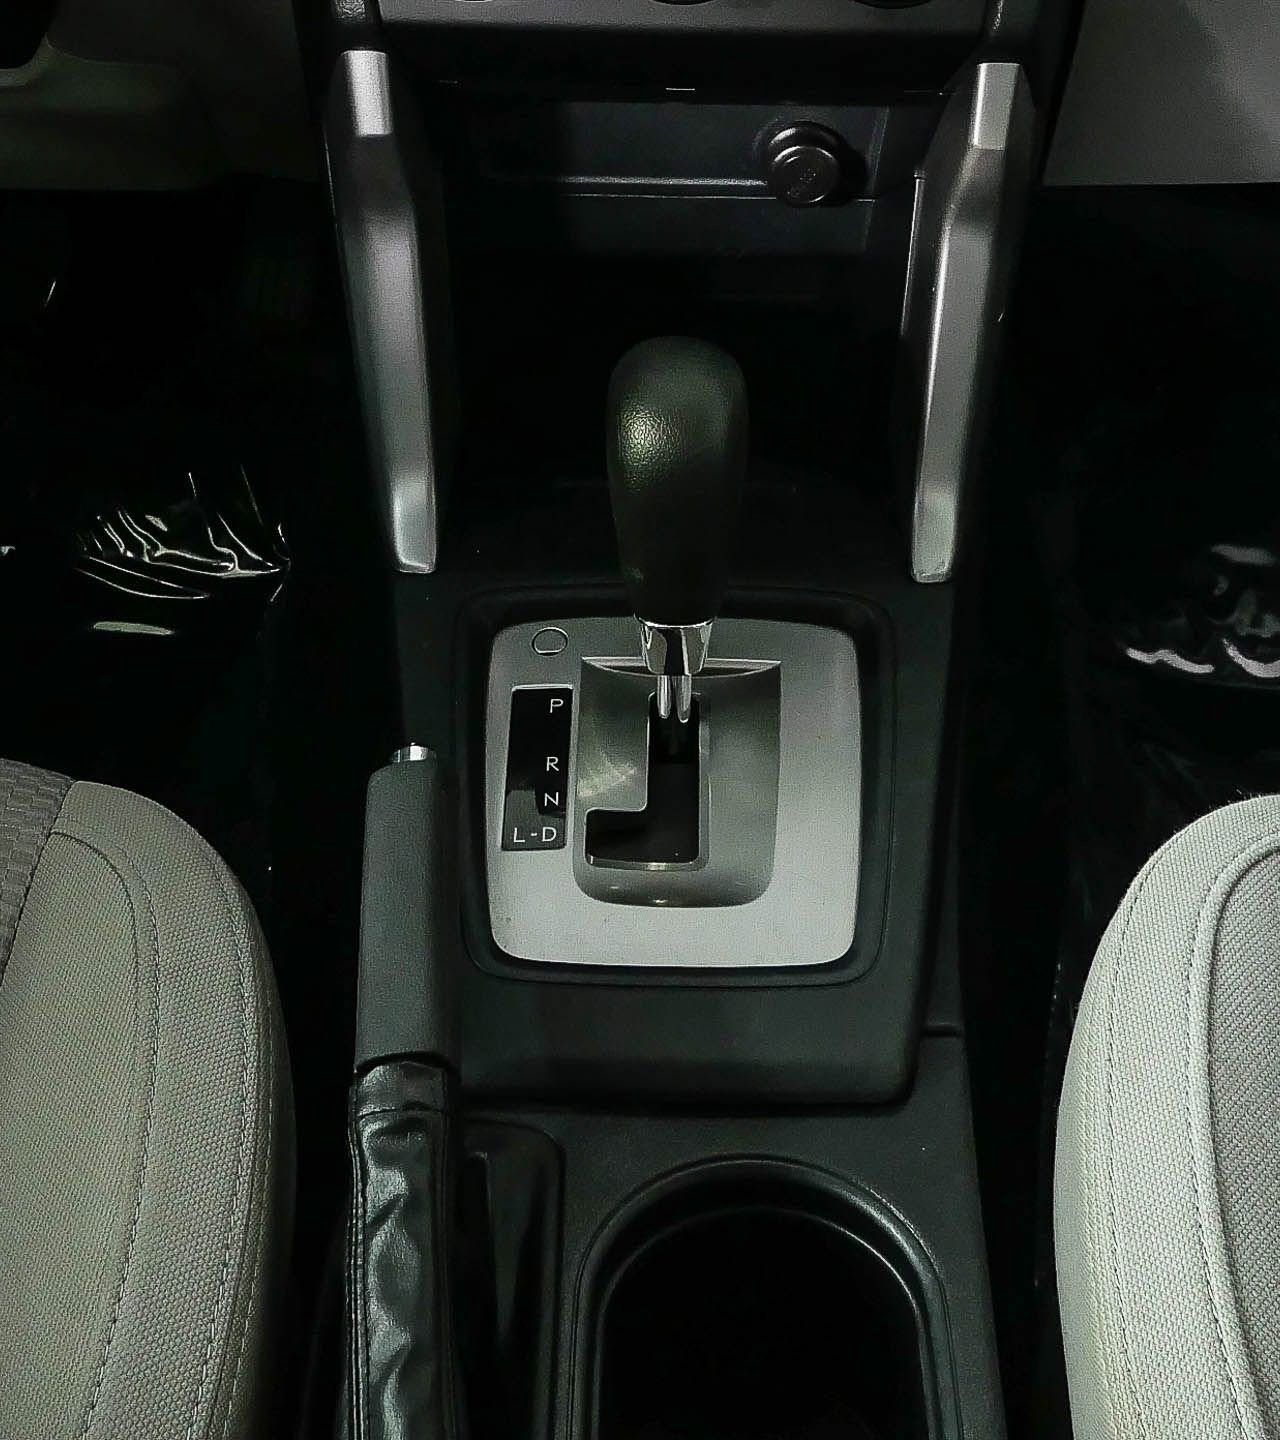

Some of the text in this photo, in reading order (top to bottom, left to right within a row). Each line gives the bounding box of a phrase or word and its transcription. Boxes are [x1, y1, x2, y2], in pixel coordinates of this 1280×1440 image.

[549, 698, 564, 713] P
[546, 757, 560, 772] R
[544, 792, 559, 807] N
